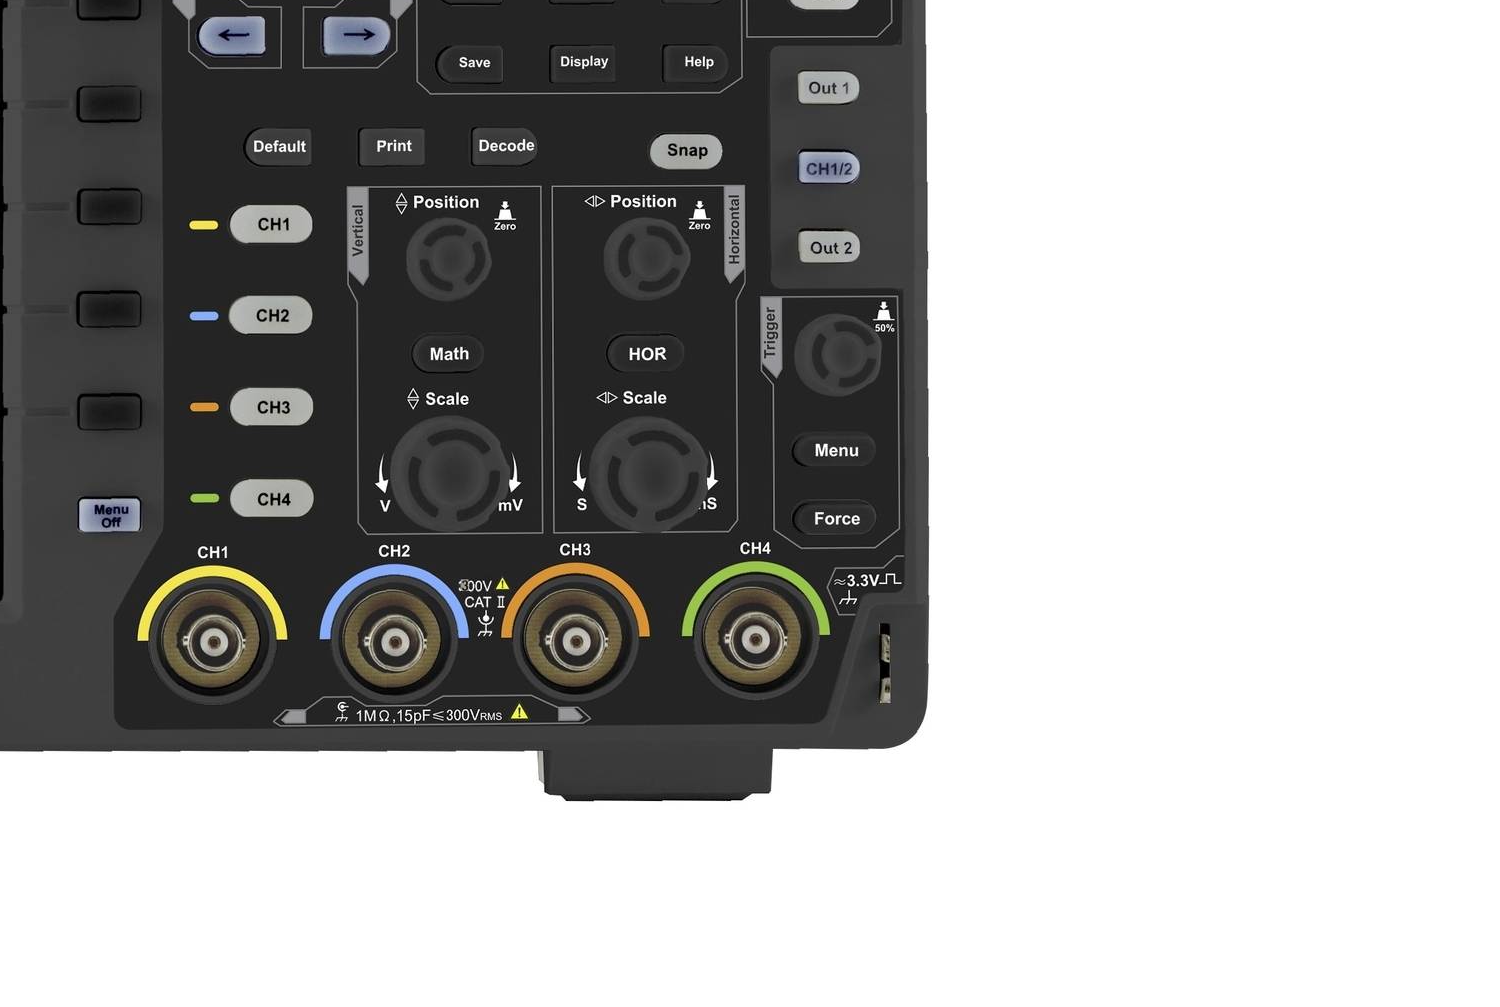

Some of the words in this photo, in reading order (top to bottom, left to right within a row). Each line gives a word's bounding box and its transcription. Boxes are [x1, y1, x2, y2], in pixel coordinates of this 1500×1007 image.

[460, 57, 490, 67] Save
[561, 56, 608, 69] Display
[685, 56, 714, 69] Help
[809, 82, 835, 94] Out
[842, 81, 849, 94] 1
[254, 140, 306, 152] Default
[377, 140, 412, 152] Print
[479, 139, 534, 151] Decode
[668, 143, 708, 159] Snap
[807, 163, 851, 175] CH1/2
[414, 196, 479, 208] Position
[611, 195, 676, 207] Position
[258, 218, 289, 231] CH1
[352, 205, 363, 256] Vertical
[495, 222, 516, 230] Zero
[689, 221, 710, 229] Zero
[728, 195, 739, 264] Horizontal
[811, 242, 838, 254] Out
[844, 242, 852, 254] 2
[257, 309, 289, 322] CH2
[764, 307, 779, 359] Trigger
[875, 324, 894, 332] 50%
[431, 347, 468, 360] Math
[630, 347, 666, 360] HOR
[426, 392, 469, 405] Scale
[623, 391, 666, 404] Scale
[258, 401, 290, 414] CH3
[816, 444, 858, 456] Menu
[258, 493, 291, 506] CH4
[499, 499, 523, 511] mV
[578, 498, 587, 510] S
[95, 505, 128, 515] Menu
[380, 500, 390, 512] V
[102, 517, 121, 528] Off
[815, 512, 860, 525] Force
[198, 546, 227, 558] CH1
[379, 545, 410, 557] CH2
[560, 543, 590, 555] CH3
[740, 542, 771, 554] CH4
[465, 596, 491, 607] CAT
